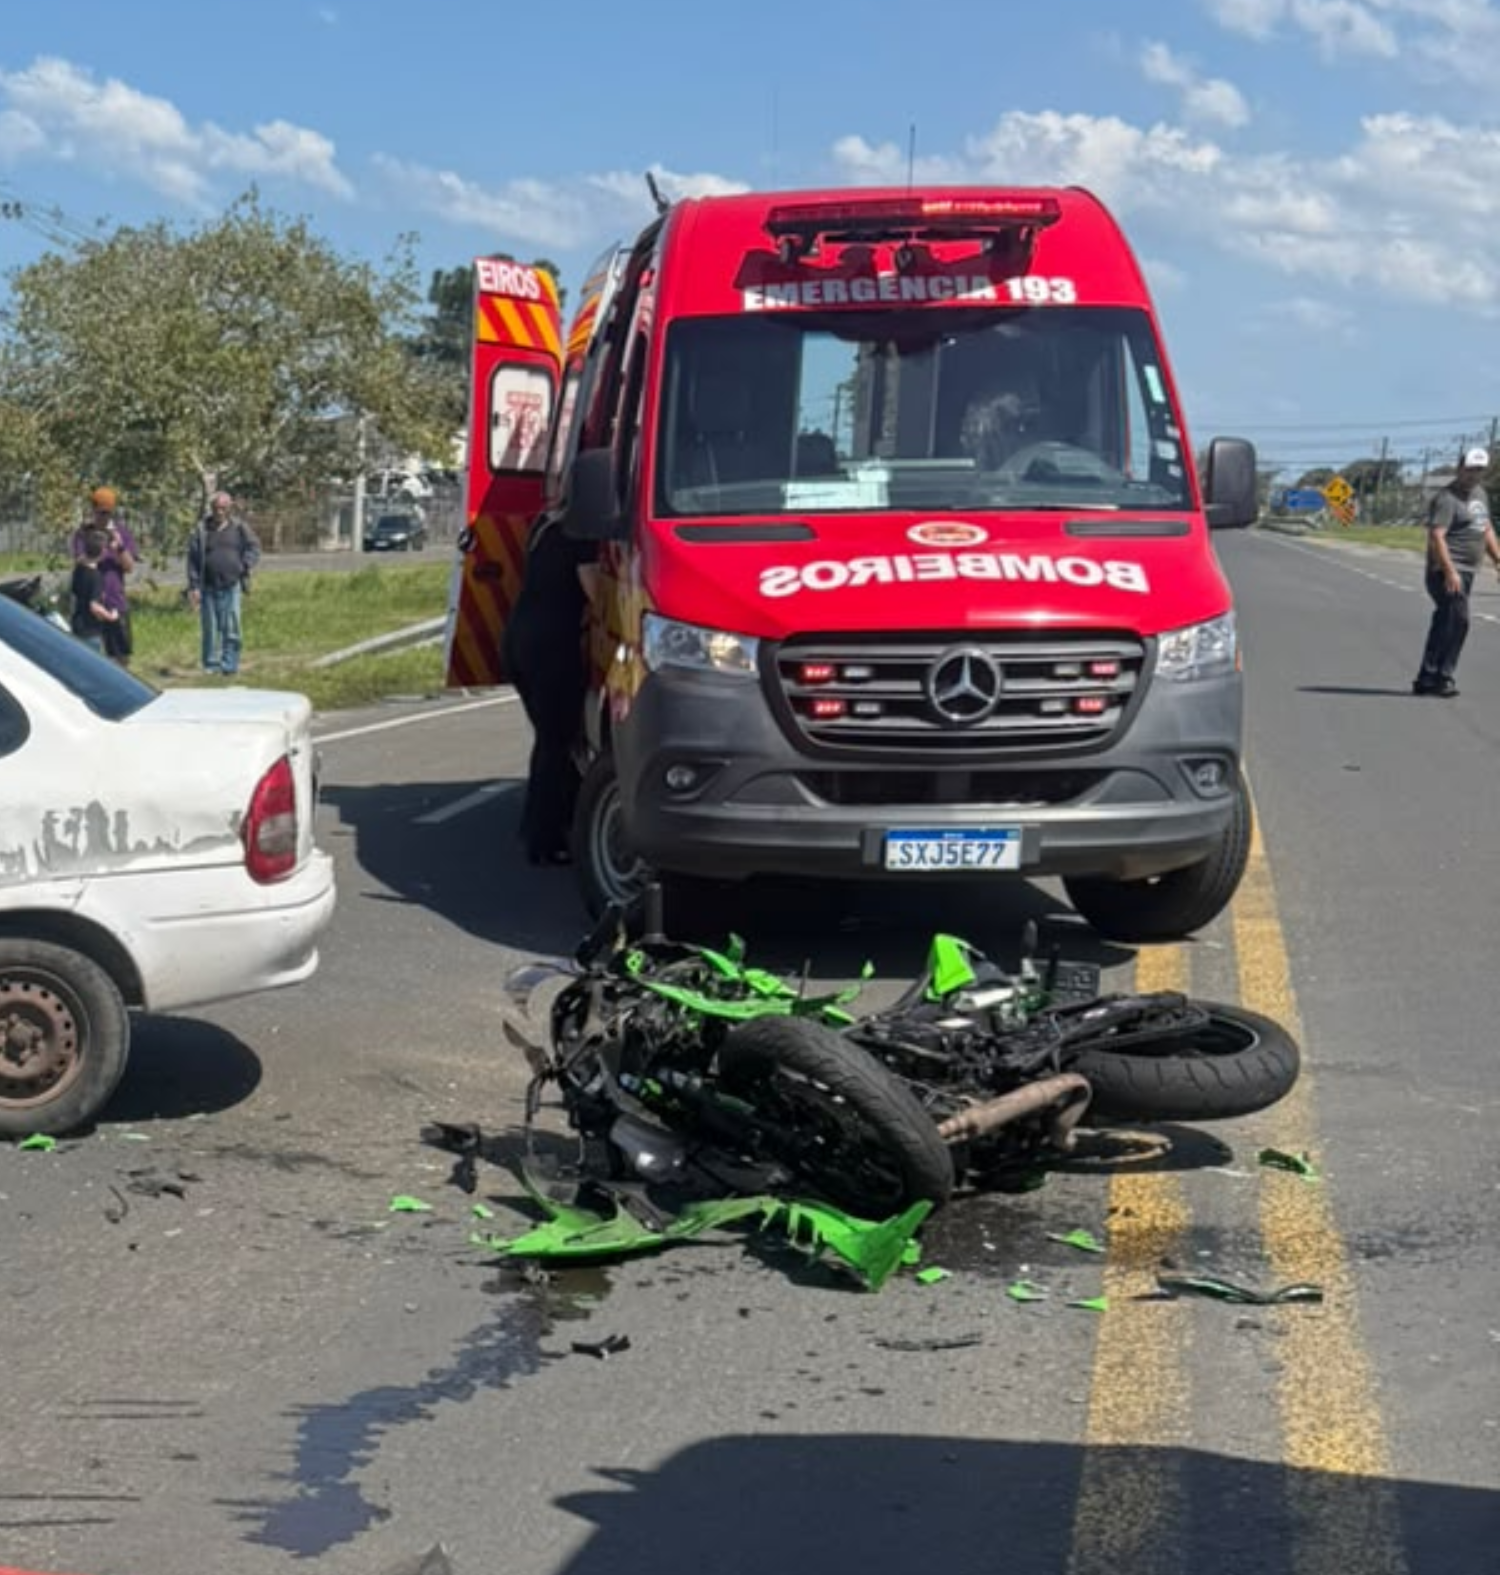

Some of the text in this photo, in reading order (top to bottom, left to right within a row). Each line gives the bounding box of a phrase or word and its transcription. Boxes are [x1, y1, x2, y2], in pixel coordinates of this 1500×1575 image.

[477, 259, 541, 299] EIROS
[1004, 274, 1076, 305] 193
[899, 842, 1006, 866] SXJ5E77
